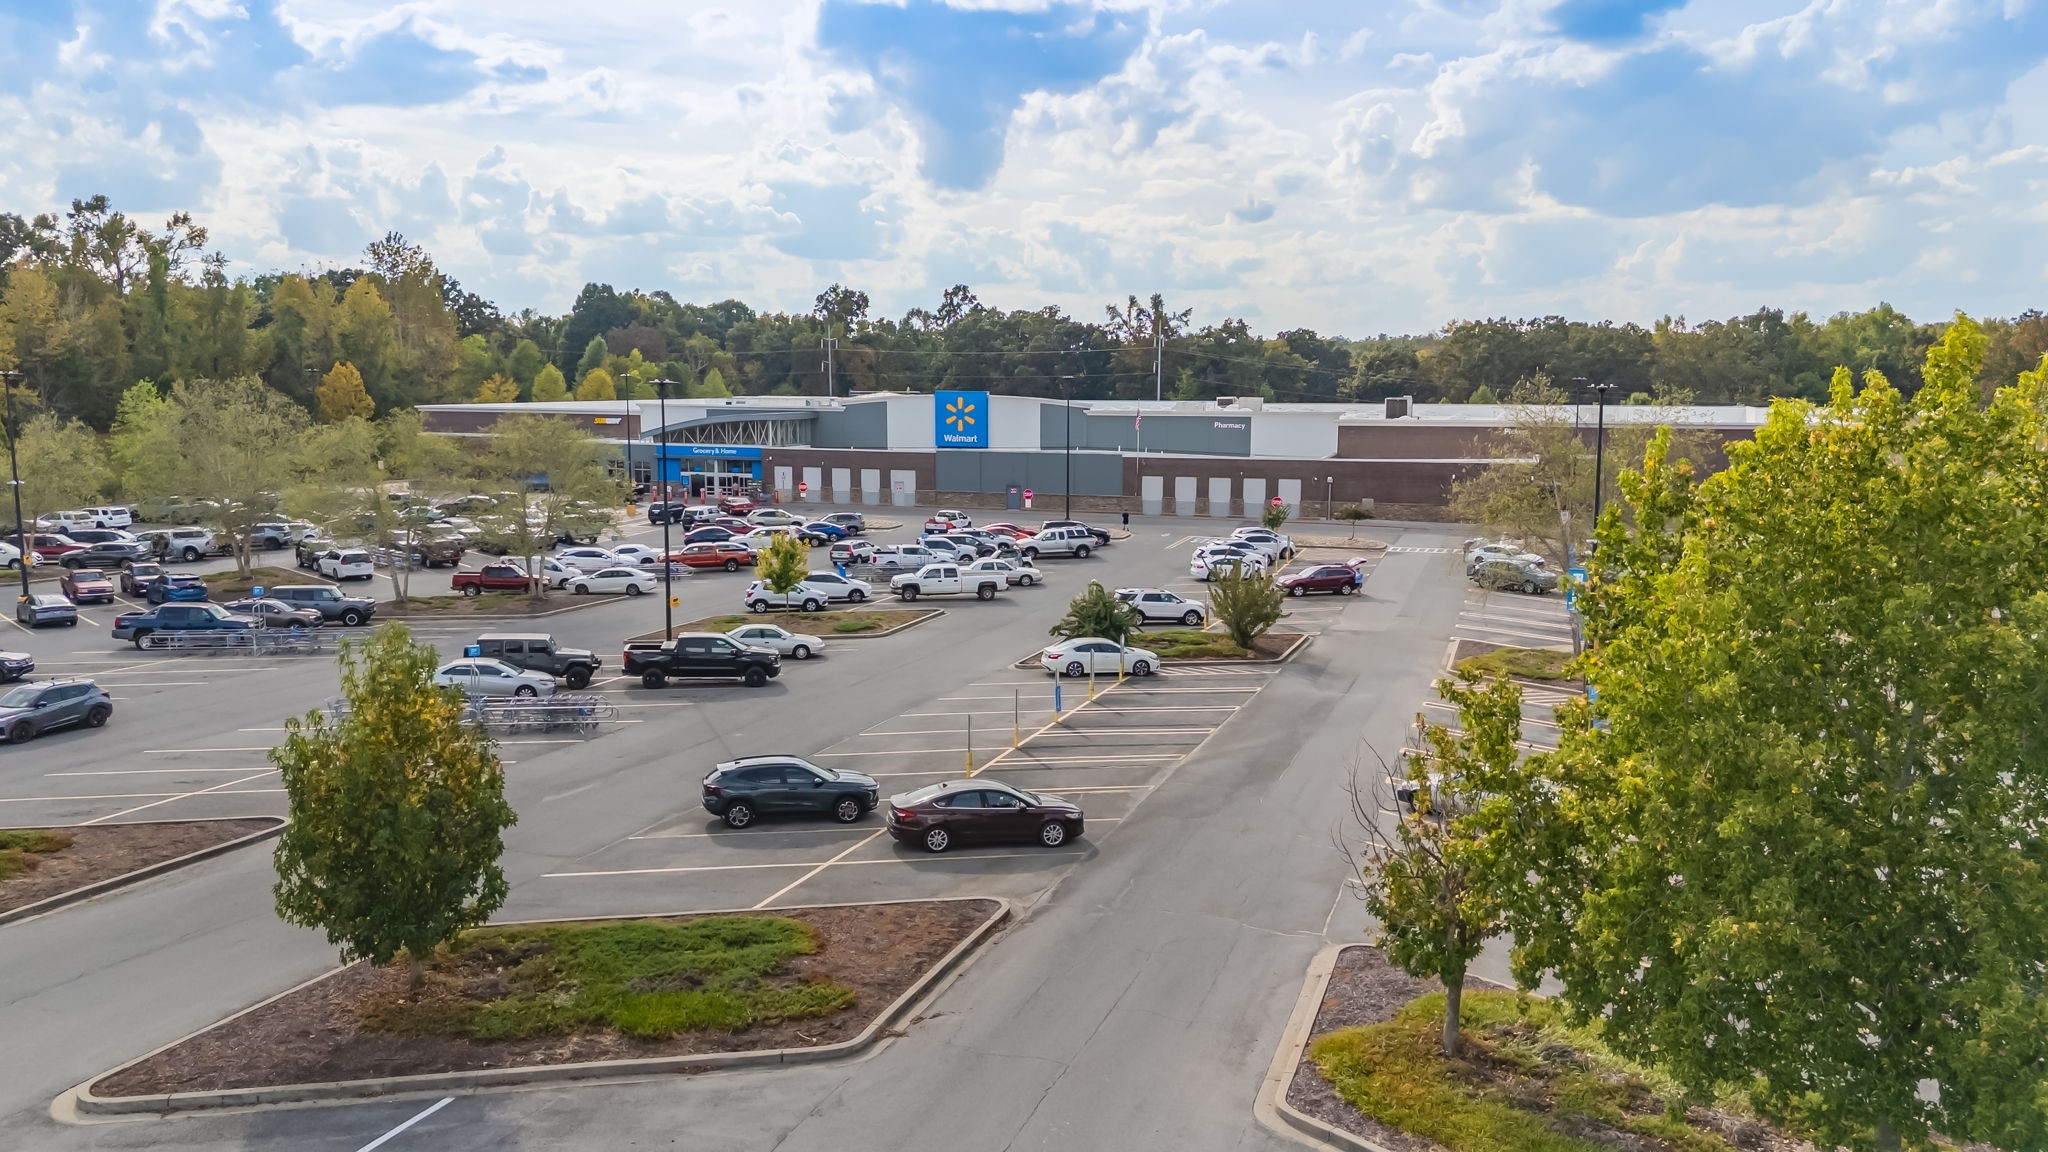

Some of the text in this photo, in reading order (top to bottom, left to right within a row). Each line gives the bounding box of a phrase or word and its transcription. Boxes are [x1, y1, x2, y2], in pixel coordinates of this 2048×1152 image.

[1214, 421, 1246, 430] Pharmacy
[943, 434, 978, 443] Walmart
[692, 447, 715, 455] Grocery
